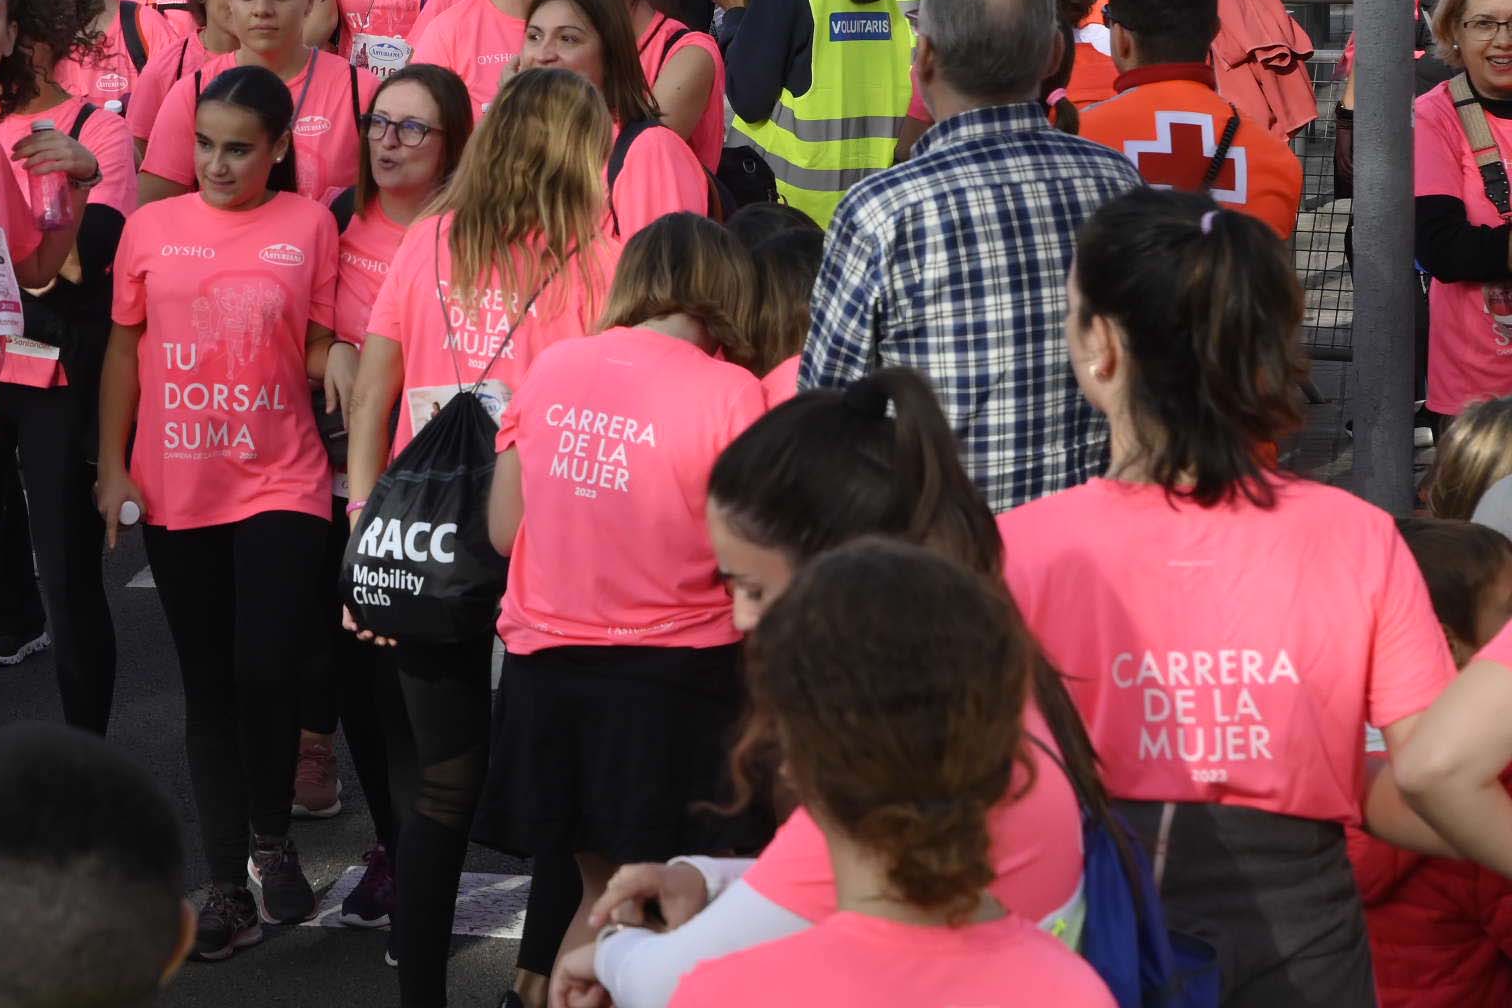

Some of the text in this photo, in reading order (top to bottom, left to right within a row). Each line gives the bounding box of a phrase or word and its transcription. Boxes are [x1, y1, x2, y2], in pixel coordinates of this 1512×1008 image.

[347, 12, 370, 29] TU
[477, 53, 514, 65] OYSH
[161, 245, 216, 259] OYSHO
[485, 311, 511, 335] LA
[163, 342, 197, 371] TU
[442, 330, 515, 360] MUJER
[164, 383, 285, 412] DORSAL
[164, 420, 255, 450] SUMA
[546, 403, 656, 448] CARRERA
[559, 429, 629, 467] DE LA
[549, 455, 631, 492] MUJER
[574, 486, 598, 499] 2023
[357, 517, 458, 564] RACC
[353, 563, 425, 595] Mobility
[353, 586, 391, 607] Club
[1111, 649, 1301, 689] CARRERA
[1144, 688, 1263, 725] DE LA
[1138, 725, 1274, 763] MUJER
[1191, 767, 1228, 783] 2023
